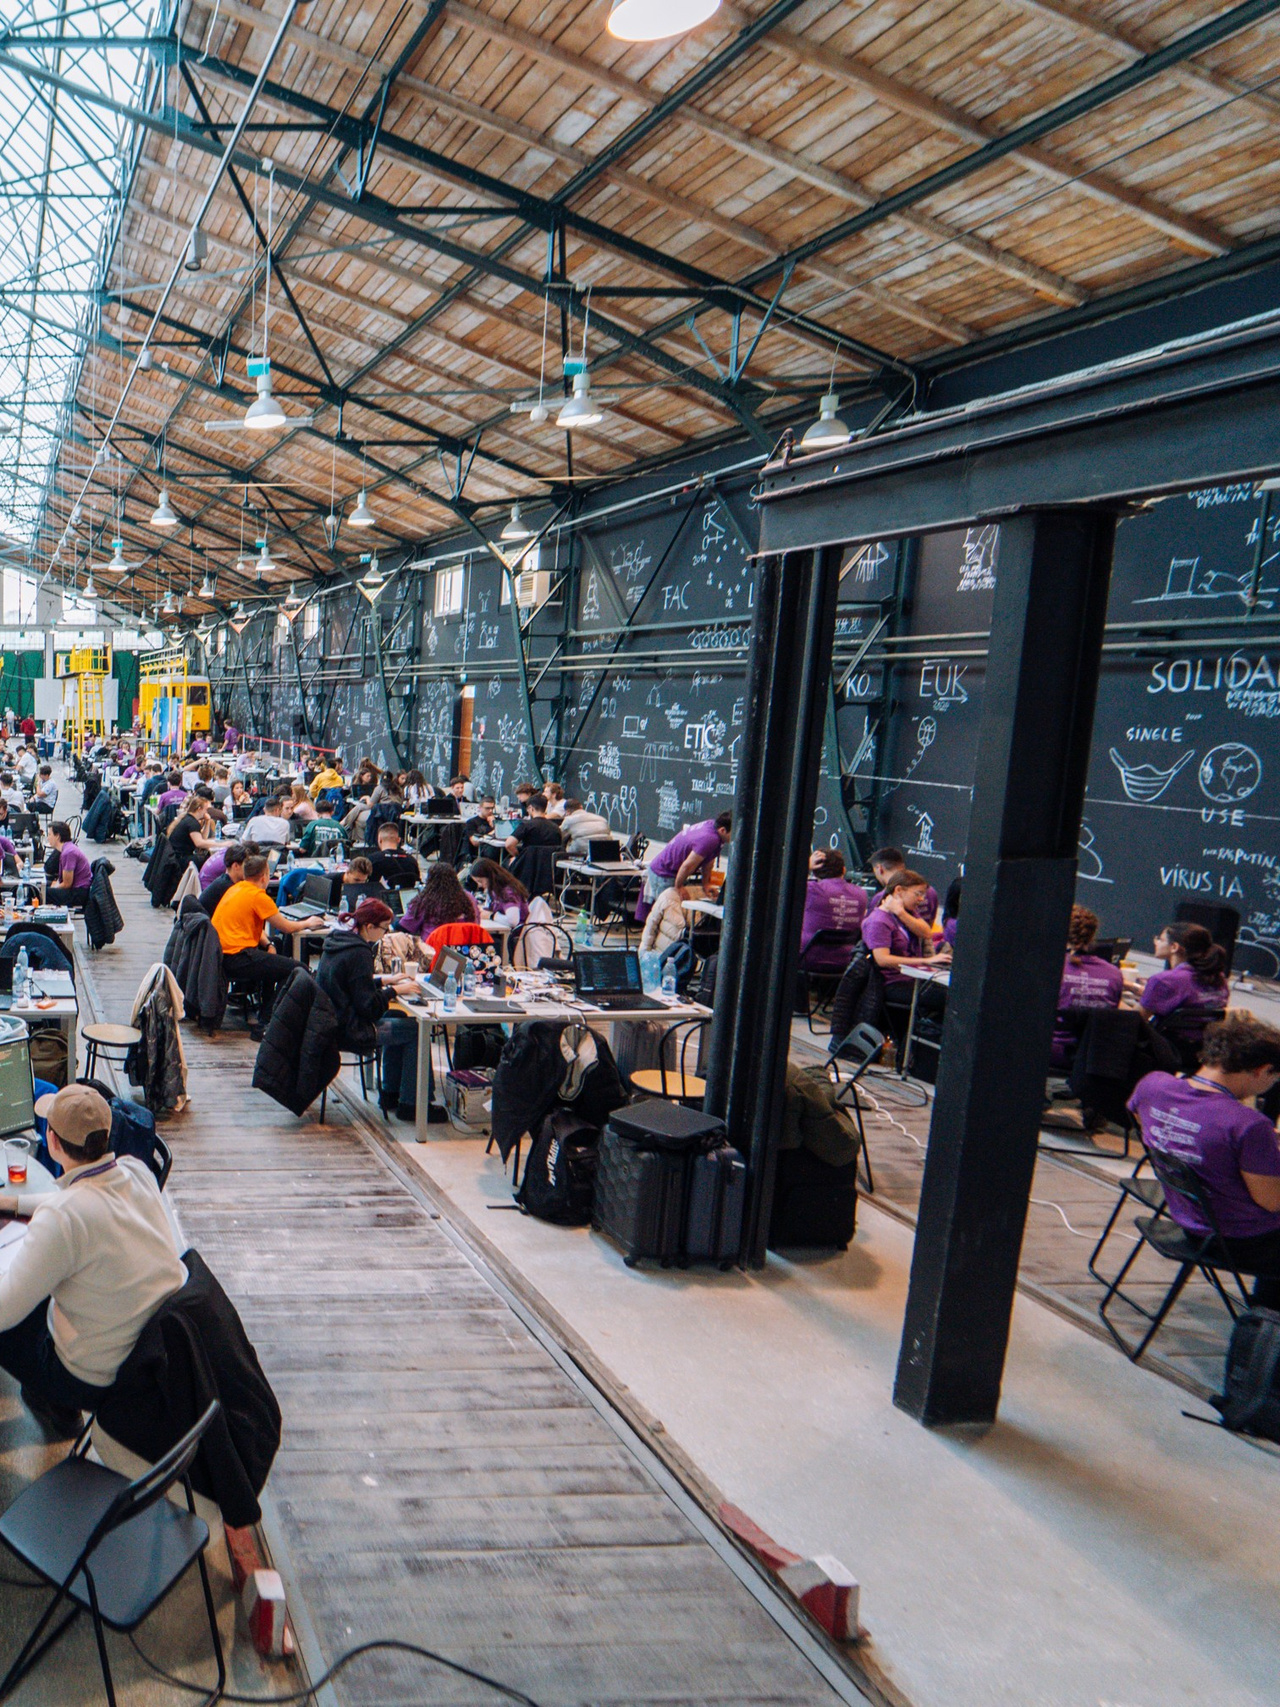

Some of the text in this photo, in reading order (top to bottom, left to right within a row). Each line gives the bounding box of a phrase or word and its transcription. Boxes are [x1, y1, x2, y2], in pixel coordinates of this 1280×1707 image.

[1146, 650, 1280, 693] SOLIDA
[1126, 724, 1183, 742] SINGLE
[1201, 807, 1245, 827] USE
